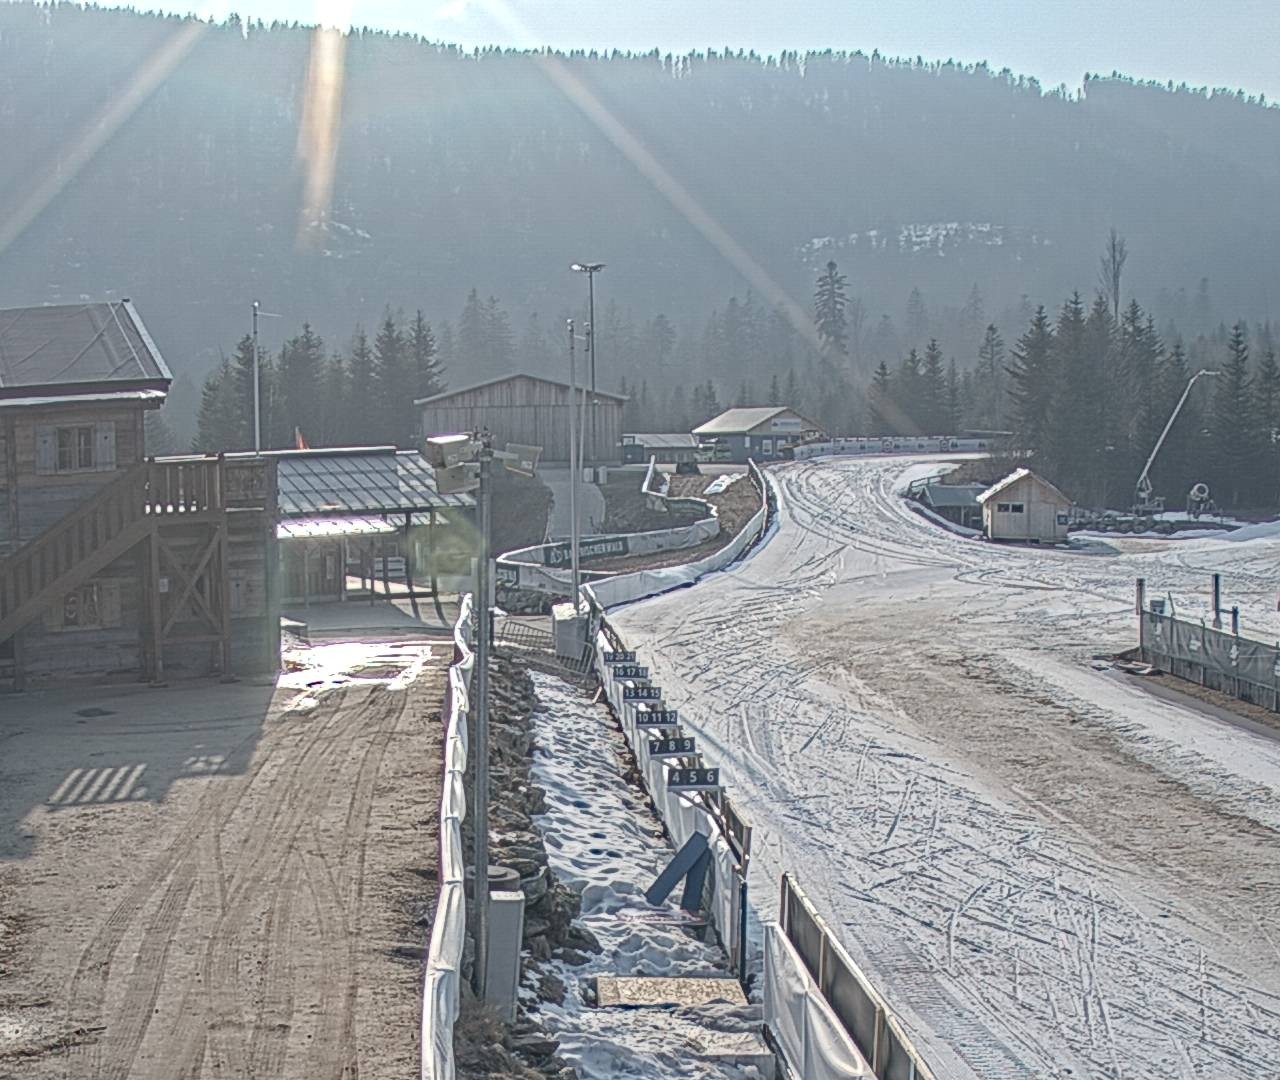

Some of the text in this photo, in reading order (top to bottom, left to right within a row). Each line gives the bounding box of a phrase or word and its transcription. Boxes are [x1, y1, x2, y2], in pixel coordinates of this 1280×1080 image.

[627, 667, 636, 676] 17
[625, 688, 660, 697] 13 14 15
[638, 713, 676, 722] 10 11 12
[653, 740, 691, 752] 7 8 9
[671, 771, 715, 783] 4 5 6
